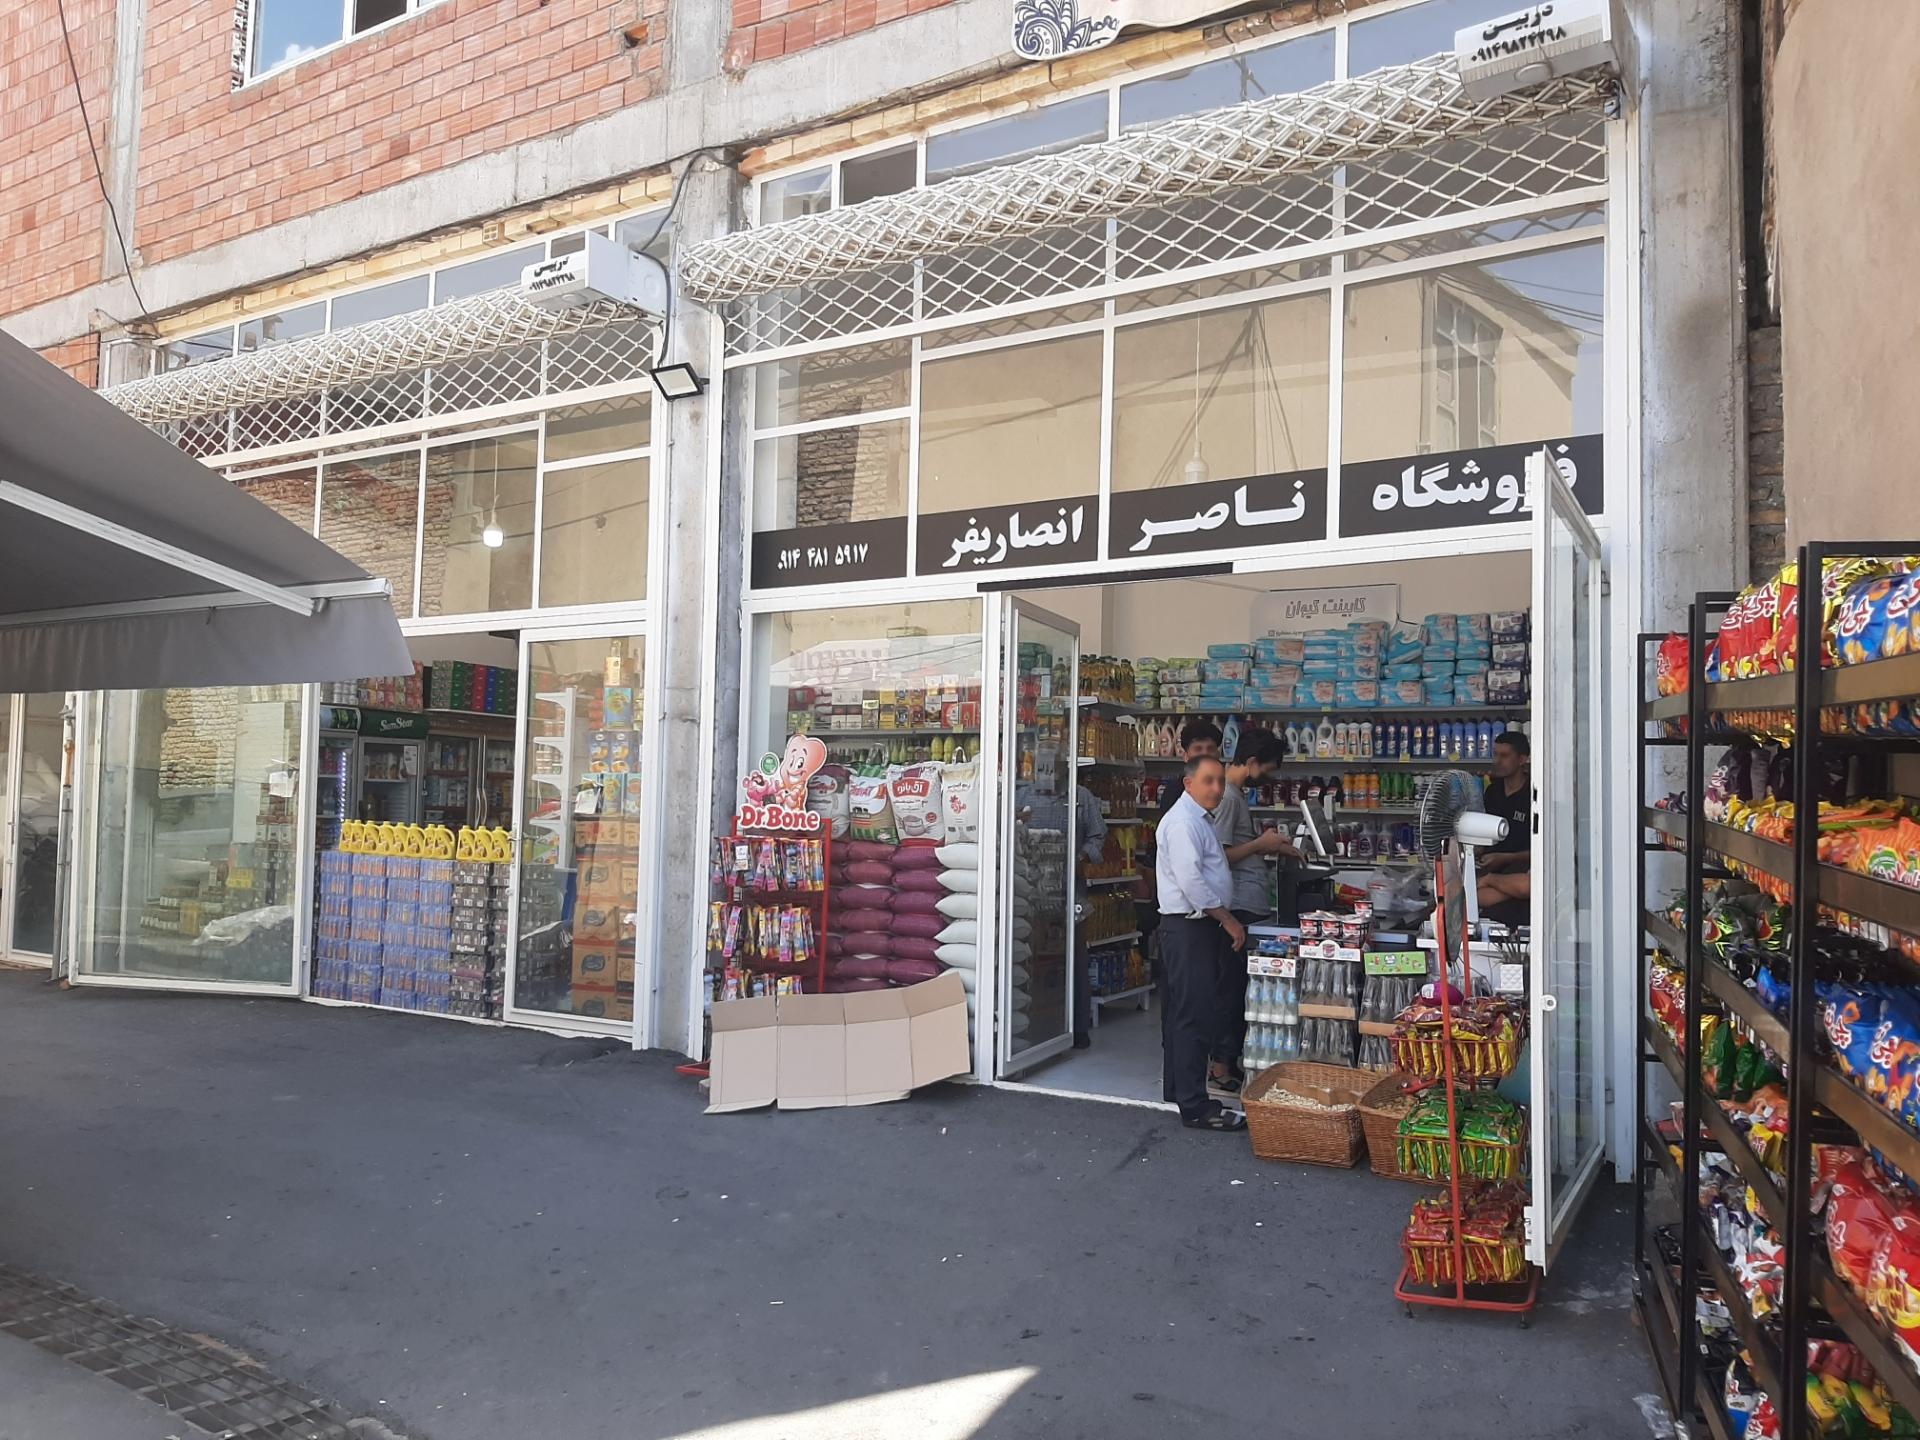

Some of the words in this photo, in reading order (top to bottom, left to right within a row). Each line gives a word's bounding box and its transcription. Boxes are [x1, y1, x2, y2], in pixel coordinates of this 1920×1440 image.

[1129, 479, 1306, 552] ناصر
[807, 546, 829, 568] ۴۸۱
[834, 543, 869, 565] ۵۹۱۷
[741, 806, 819, 831] Dr.Bone
